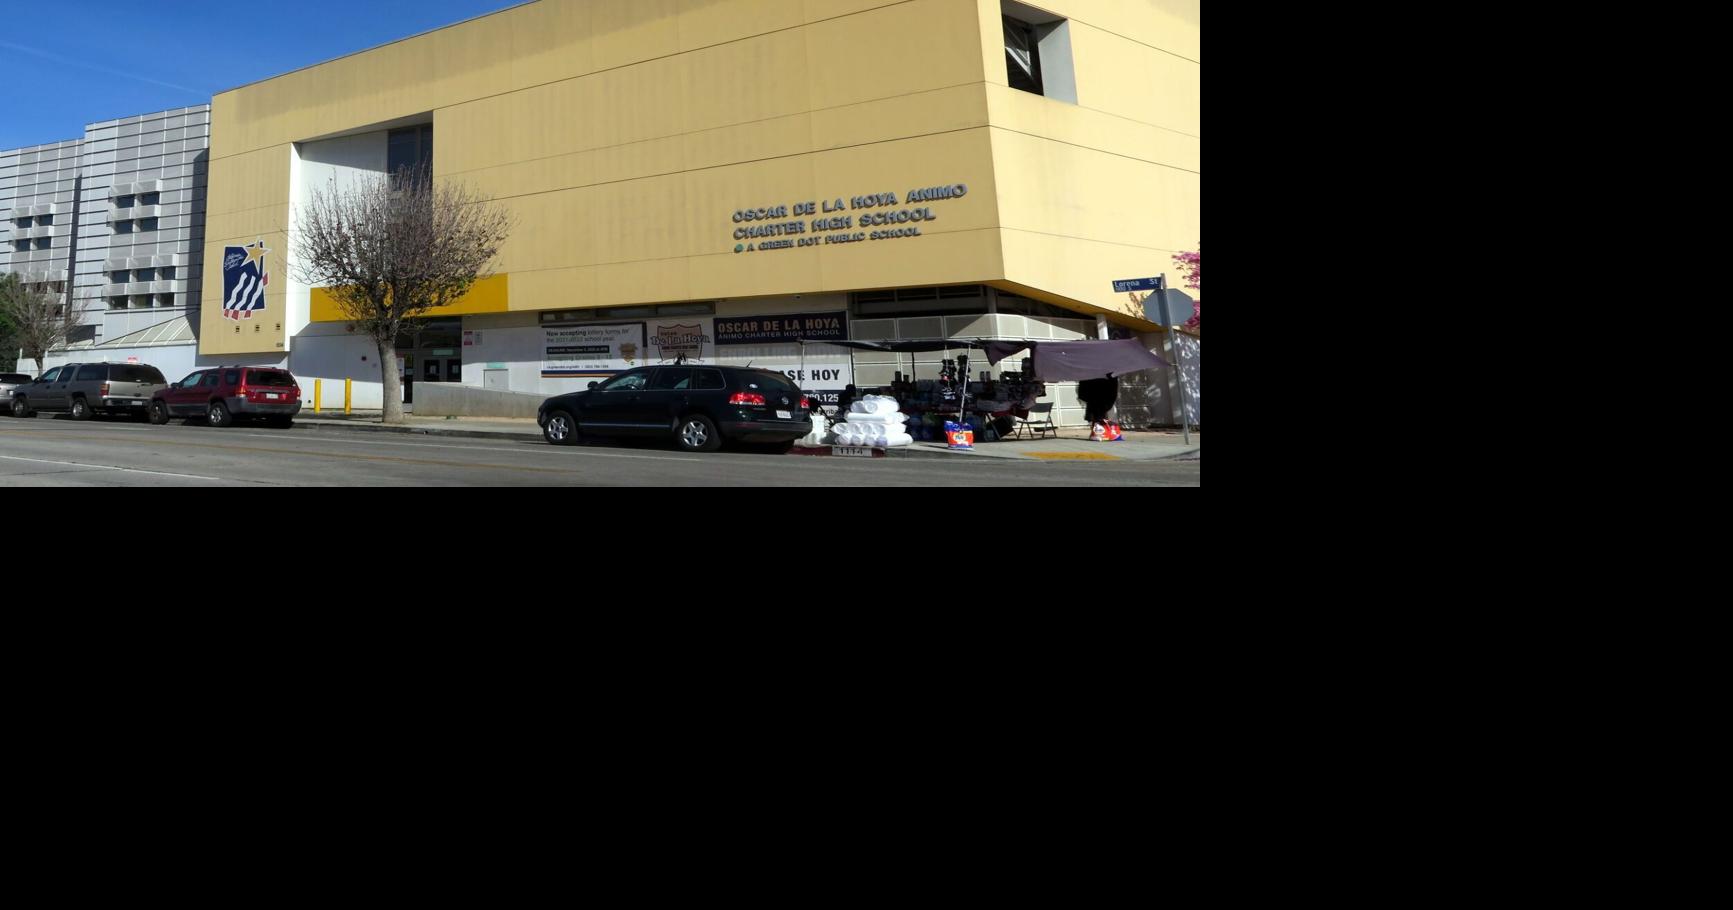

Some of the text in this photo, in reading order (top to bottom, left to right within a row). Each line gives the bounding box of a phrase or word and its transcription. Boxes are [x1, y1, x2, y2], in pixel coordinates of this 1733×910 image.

[732, 183, 968, 223] OSCAR DE LA HOYA ANIMO
[733, 207, 936, 240] CHARTER HIGH SCHOOL
[746, 227, 922, 253] A GREEN DOT PUBLIC SCHOOL
[1114, 280, 1140, 288] Lorena
[718, 318, 840, 333] OSCAR DE LA HOYA
[559, 329, 587, 337] accepting
[718, 332, 743, 340] ANIMO
[745, 331, 780, 339] CHARTER
[811, 369, 840, 381] HOY
